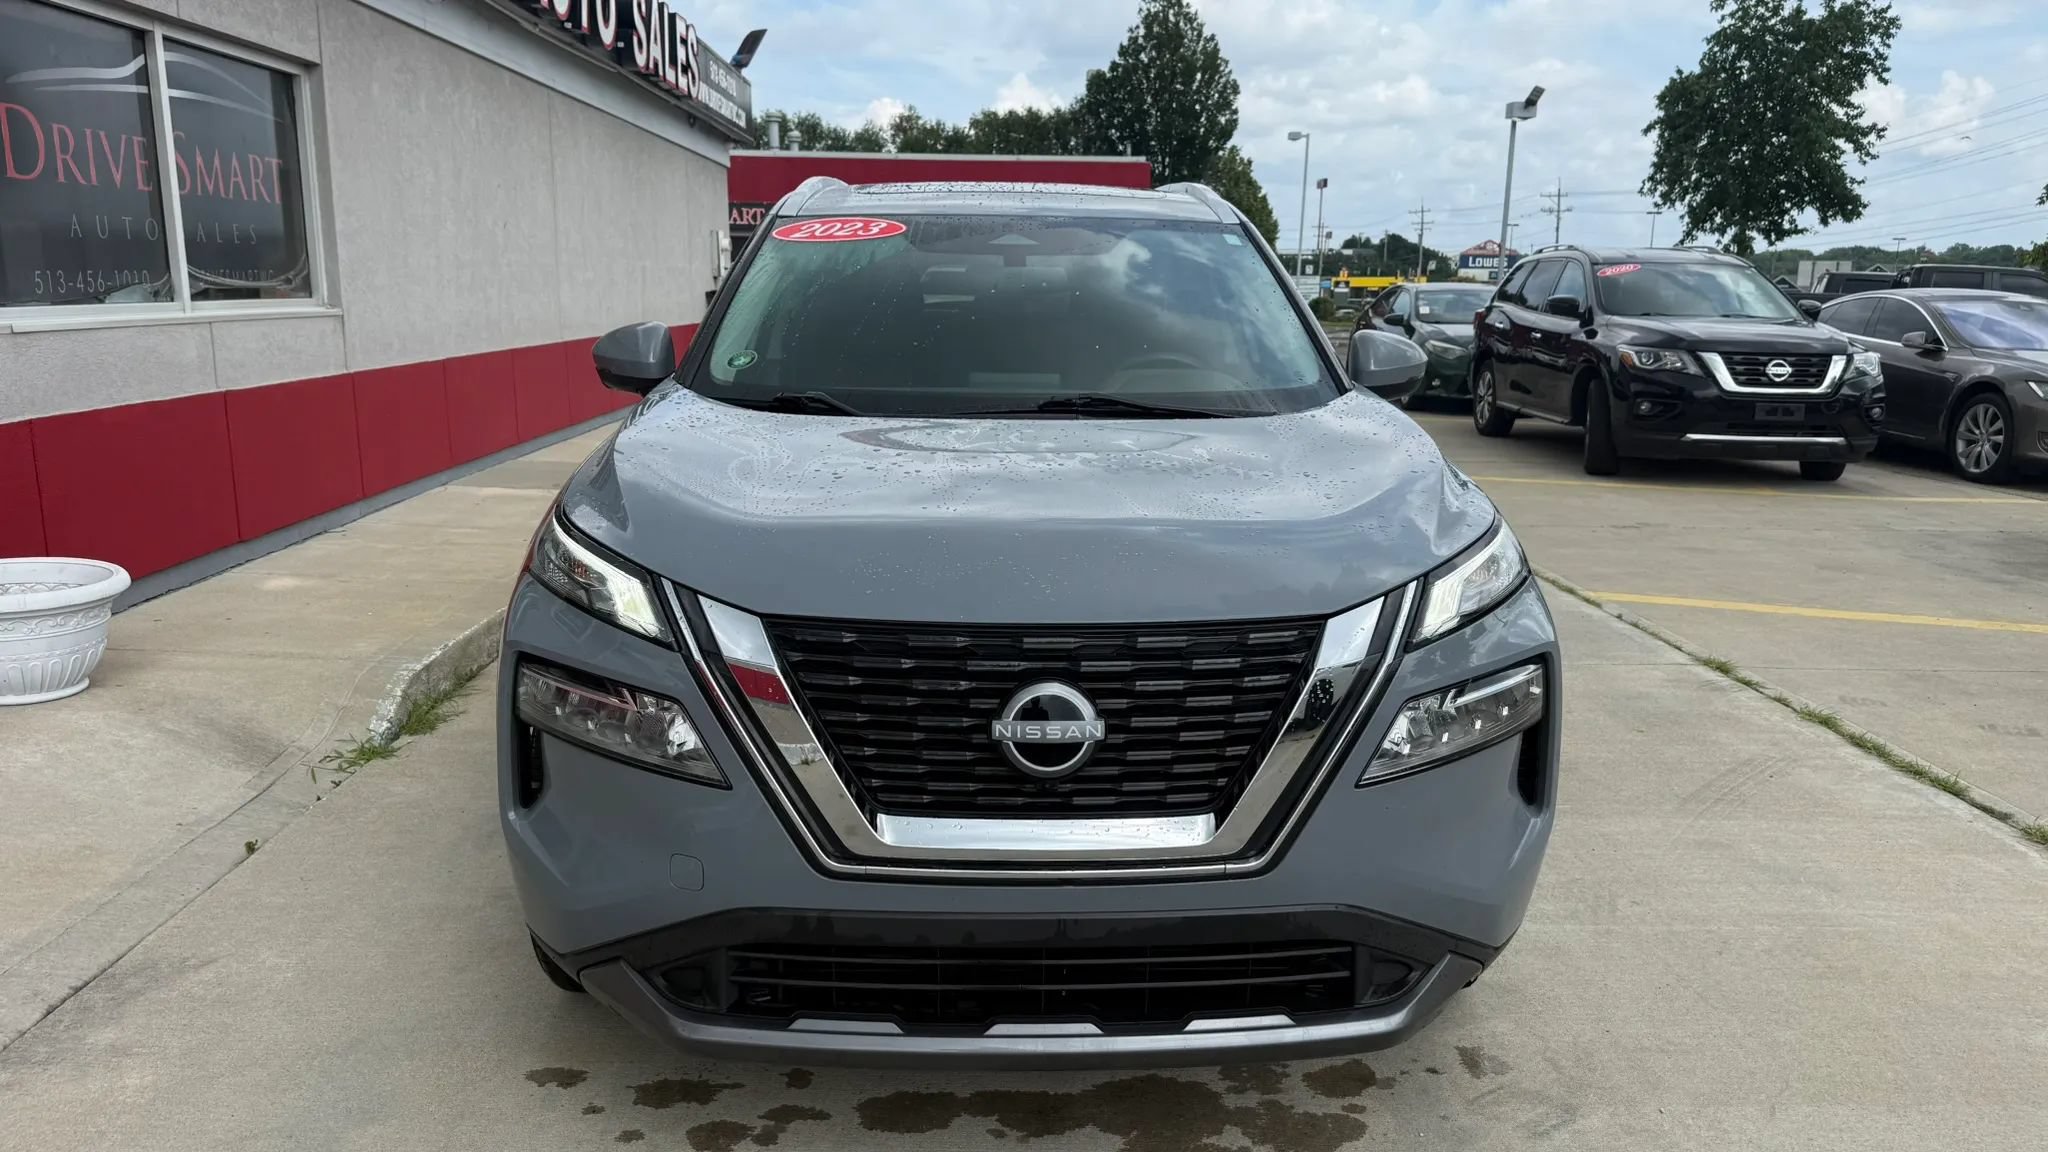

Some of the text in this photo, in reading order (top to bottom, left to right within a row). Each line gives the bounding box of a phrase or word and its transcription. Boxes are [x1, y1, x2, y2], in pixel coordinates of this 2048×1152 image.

[633, 0, 700, 102] SALES
[0, 103, 283, 205] DRIVE SMART
[70, 213, 257, 245] AUTO ALES
[789, 221, 888, 239] 2023
[1606, 263, 1635, 276] 2020
[994, 723, 1102, 739] NISSAN
